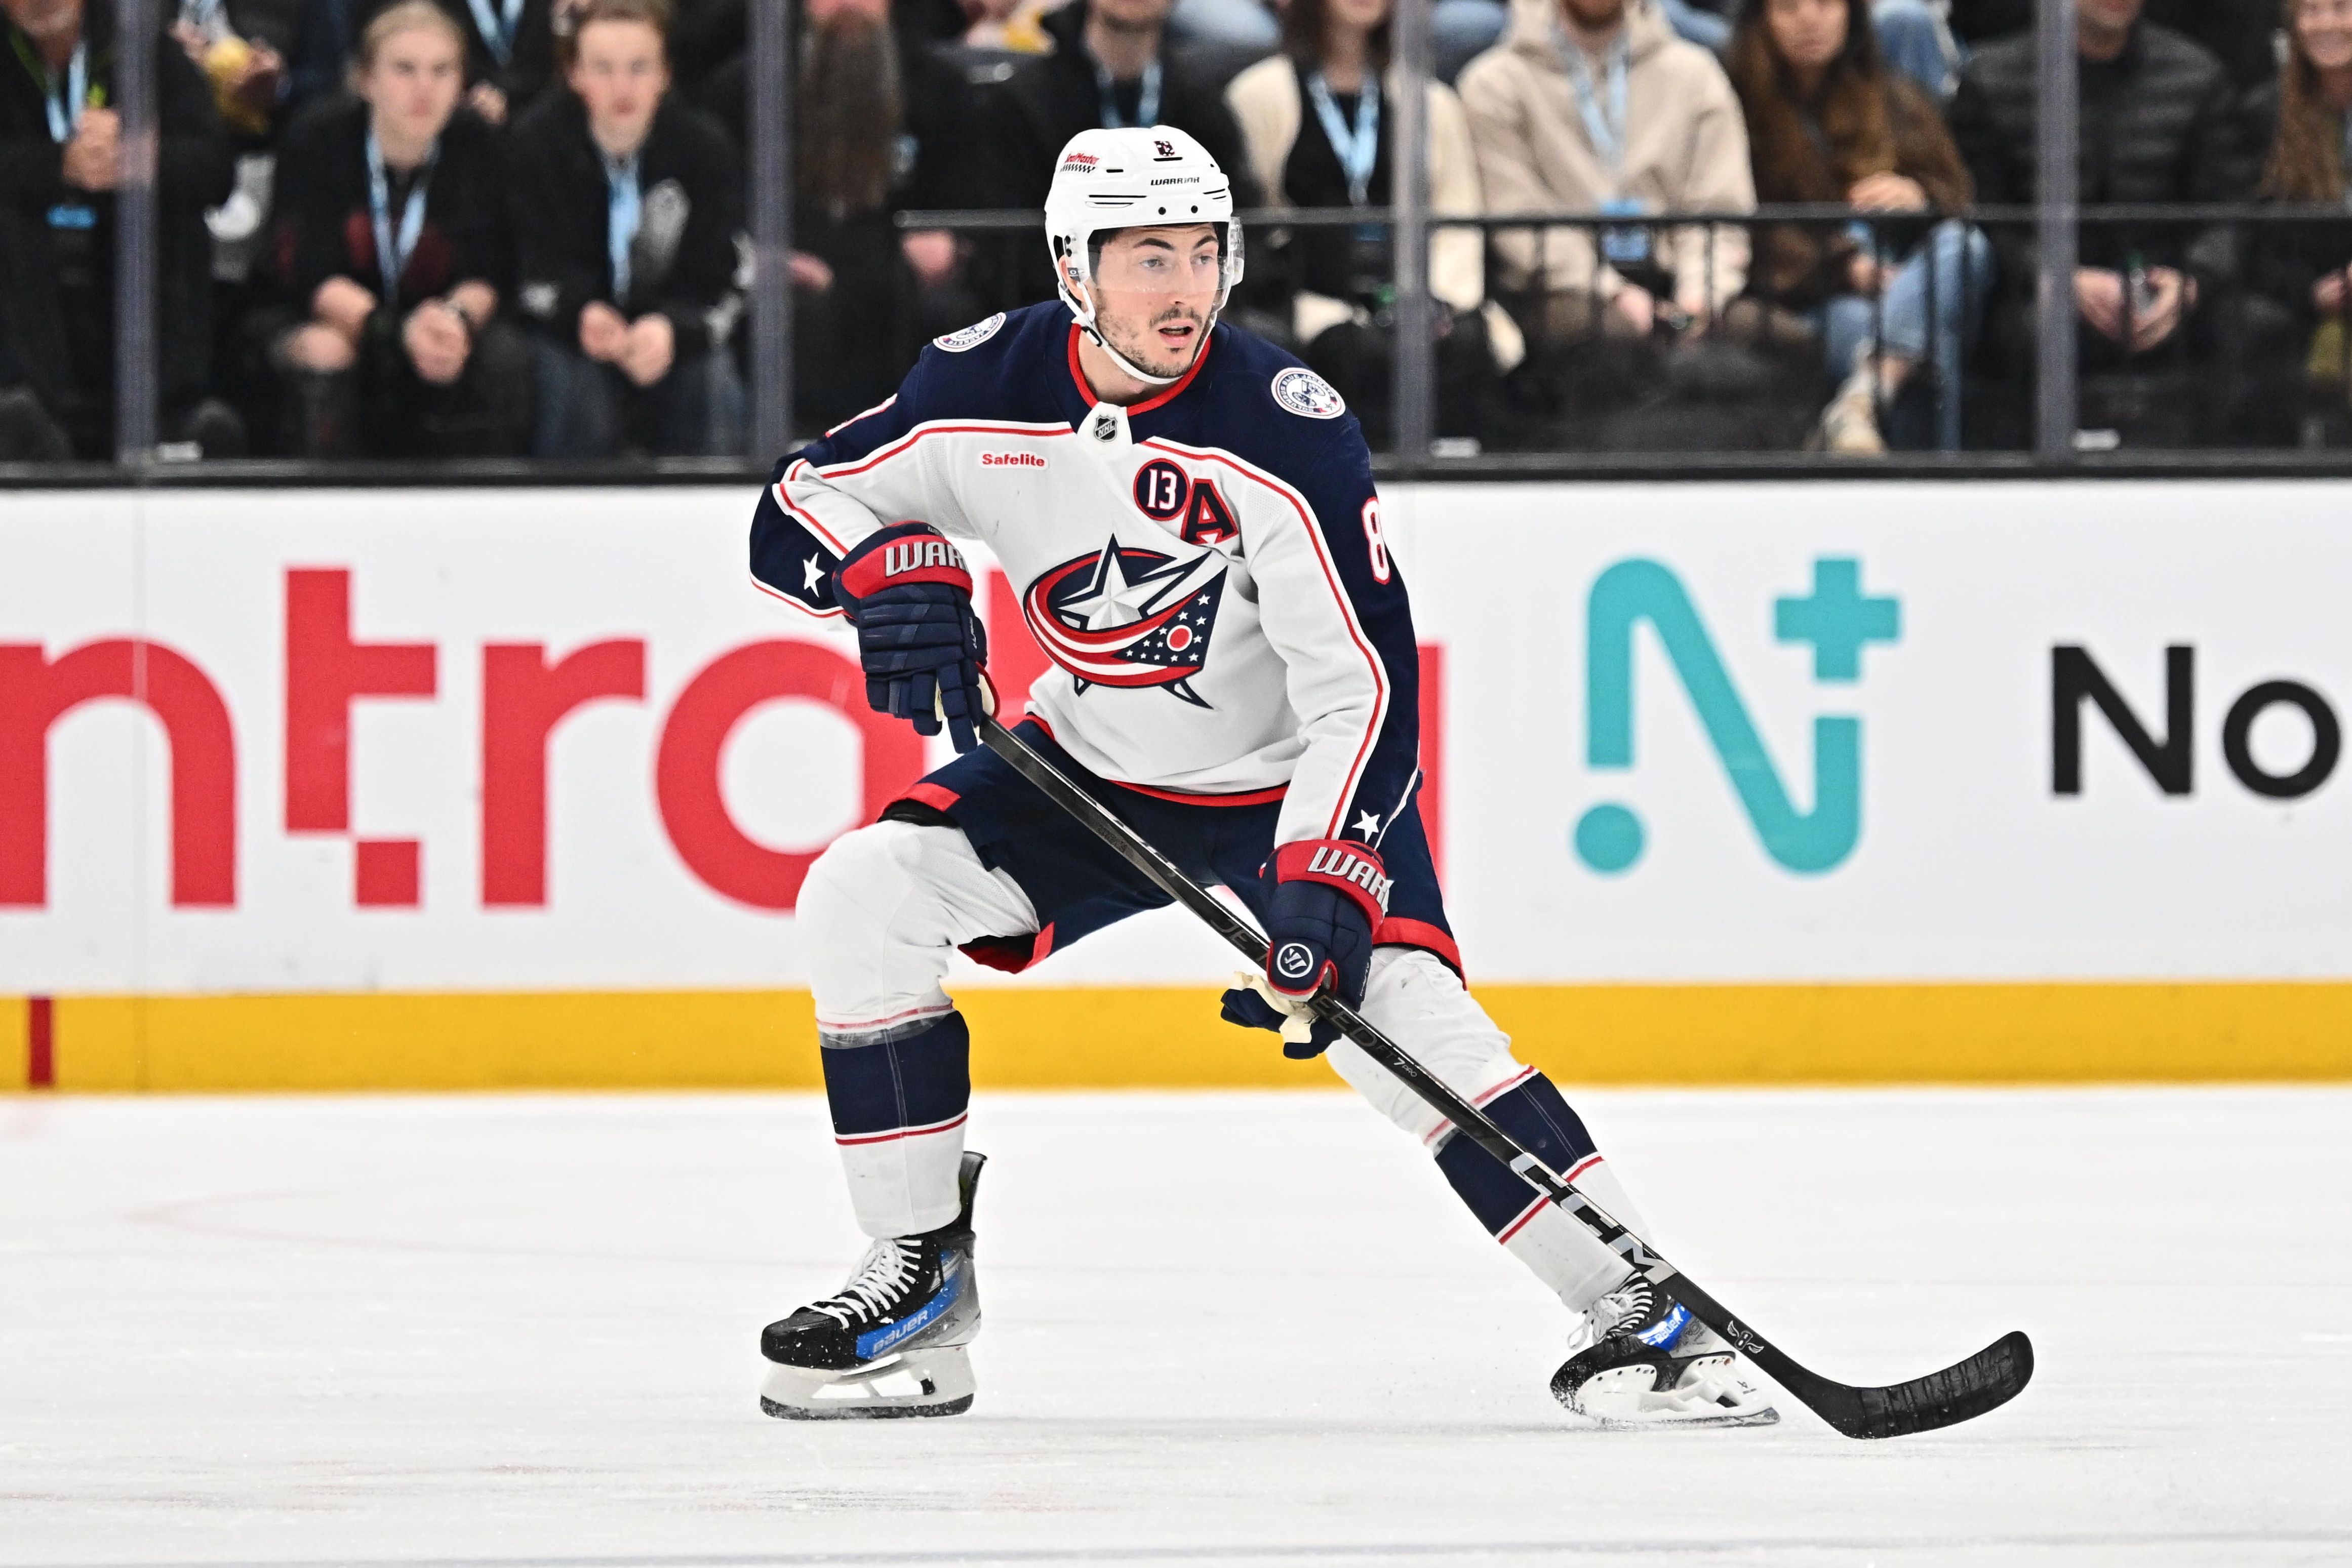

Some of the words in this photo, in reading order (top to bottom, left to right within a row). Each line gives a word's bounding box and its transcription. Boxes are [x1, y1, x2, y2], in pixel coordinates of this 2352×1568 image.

[982, 454, 1045, 467] Safelite
[1147, 468, 1178, 509] 13
[1180, 478, 1239, 545] A
[1361, 496, 1391, 585] 8
[886, 542, 970, 577] WAR
[2051, 644, 2341, 800] No
[1307, 847, 1394, 912] WAR
[1509, 1152, 1678, 1285] CCM
[873, 1309, 928, 1353] BAUER
